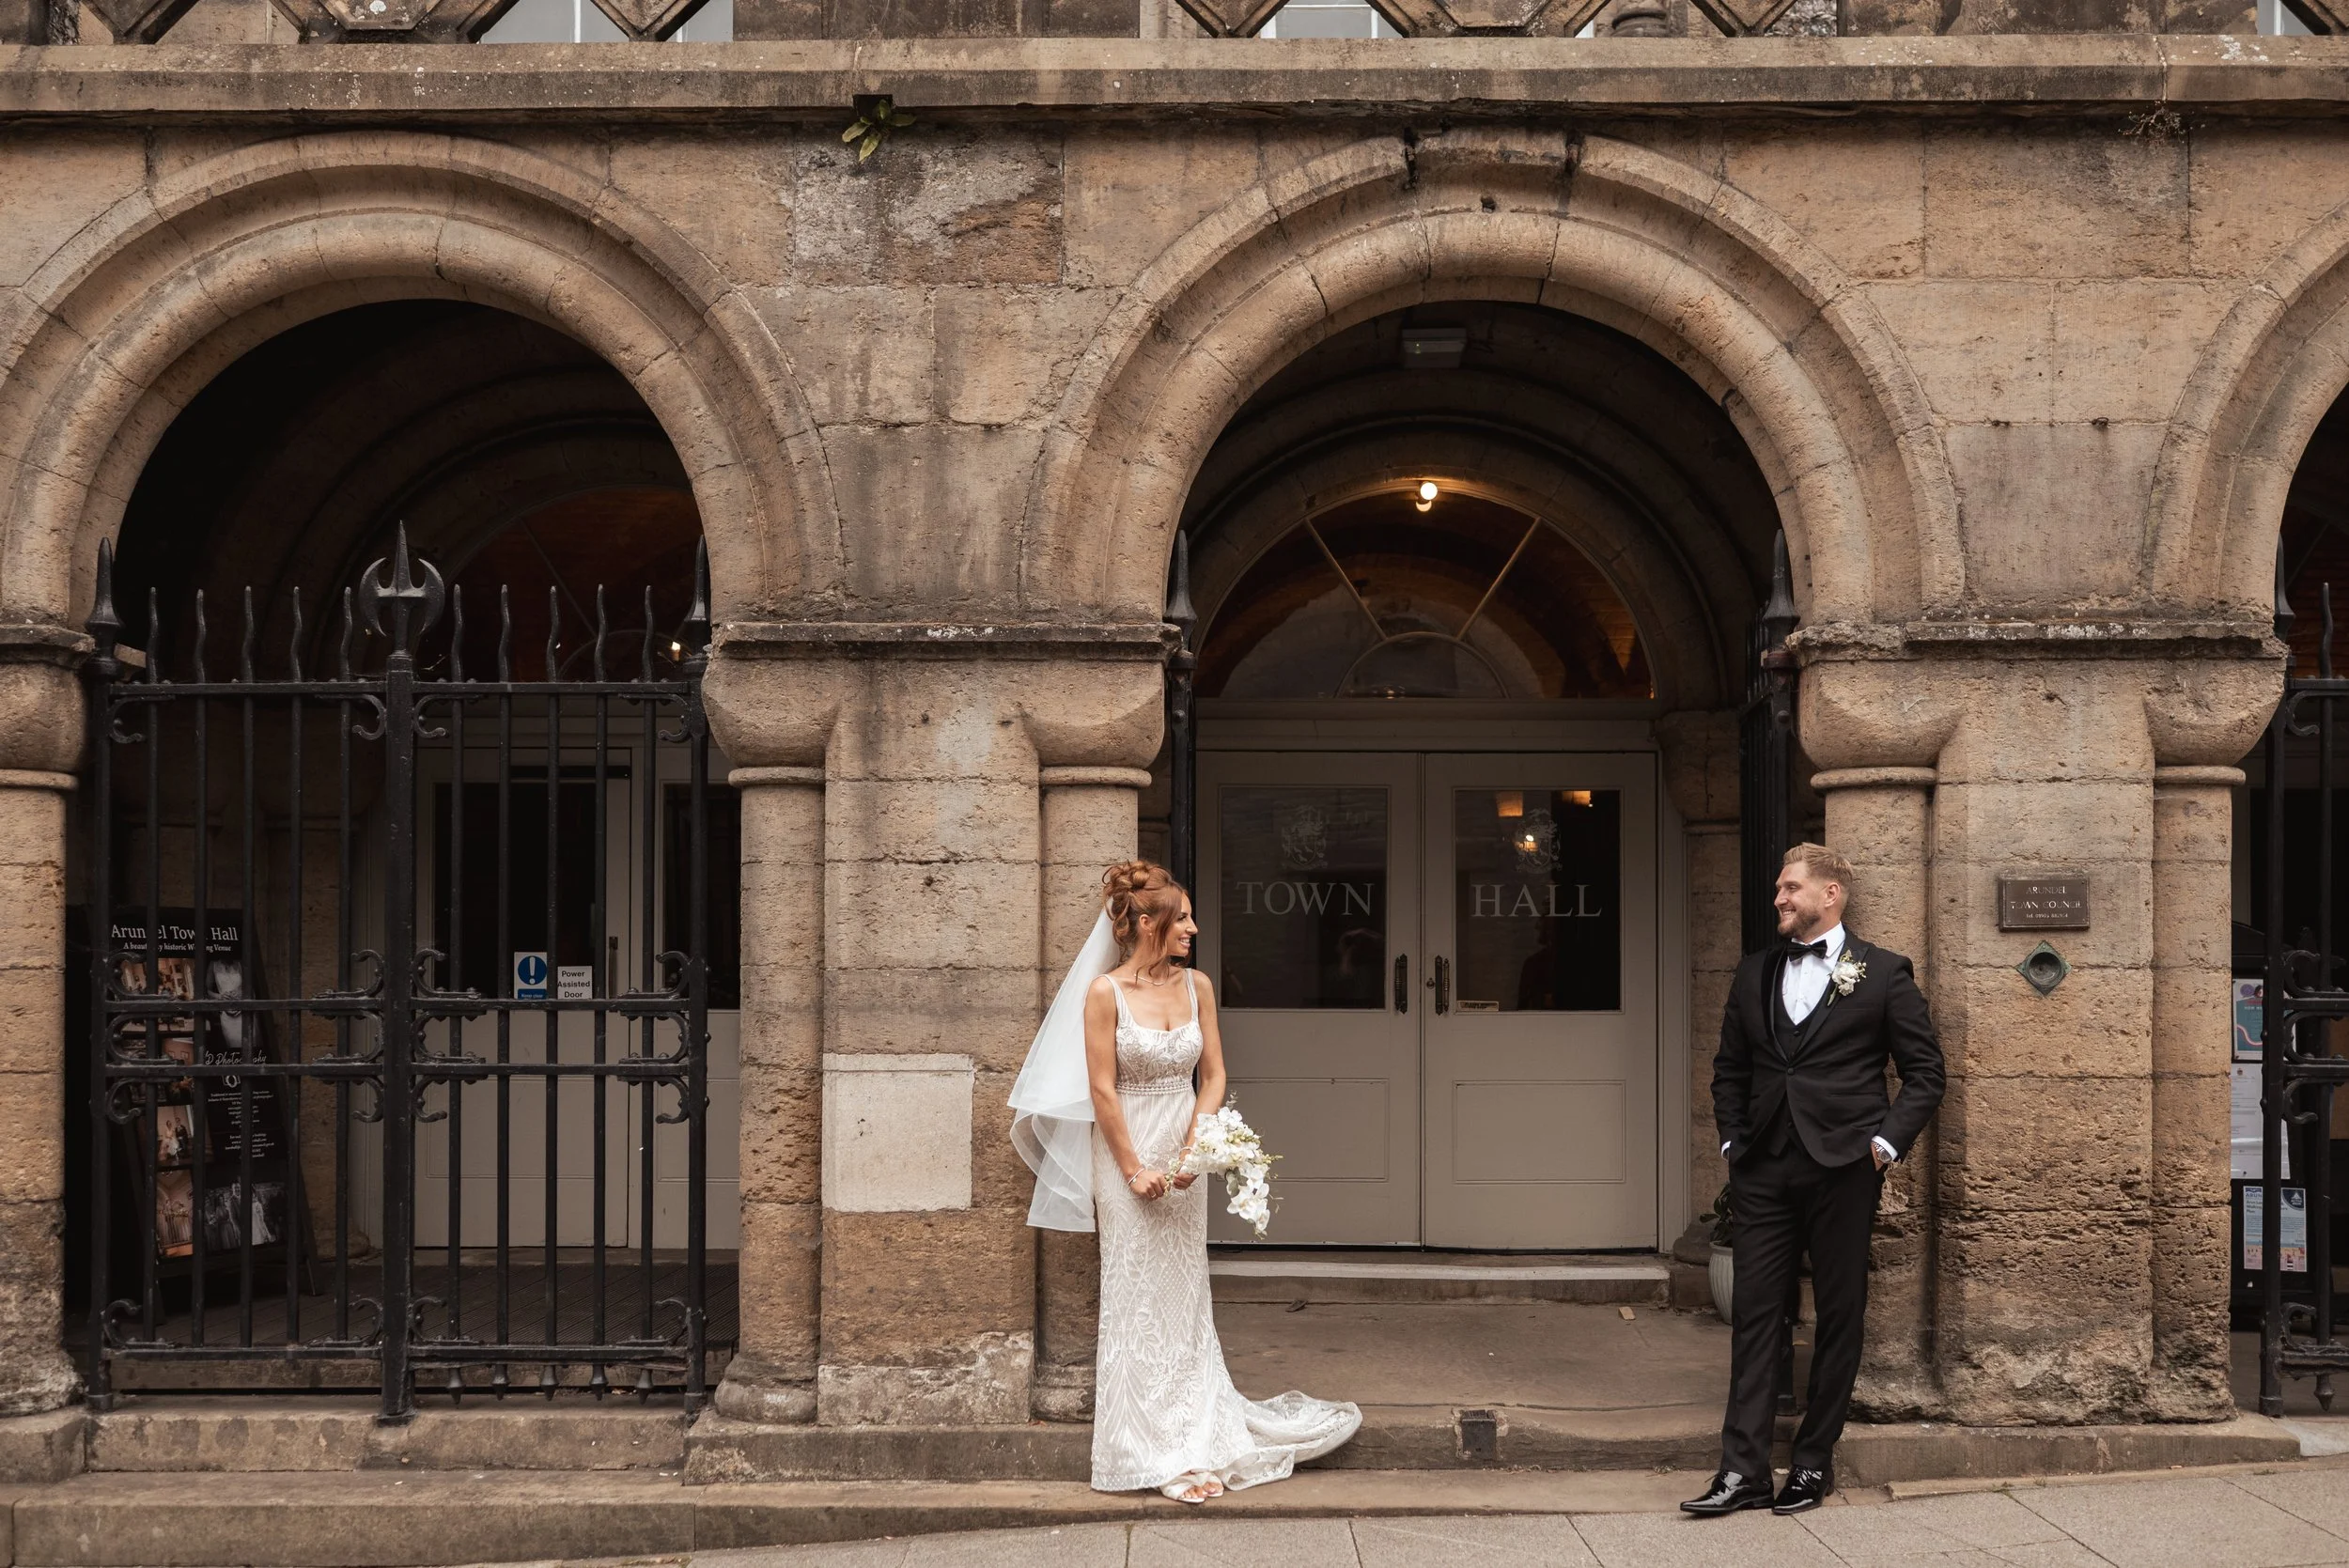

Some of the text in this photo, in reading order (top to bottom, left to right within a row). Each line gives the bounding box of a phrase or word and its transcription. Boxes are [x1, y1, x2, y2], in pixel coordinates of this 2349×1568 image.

[2026, 886, 2067, 894] ARUNDEL
[1237, 880, 1603, 918] TOWN HALL
[2011, 900, 2083, 909] TOWN COUNCIL
[111, 924, 239, 940] Arunel Tow Hall
[130, 942, 163, 952] beauty
[163, 943, 186, 952] historic
